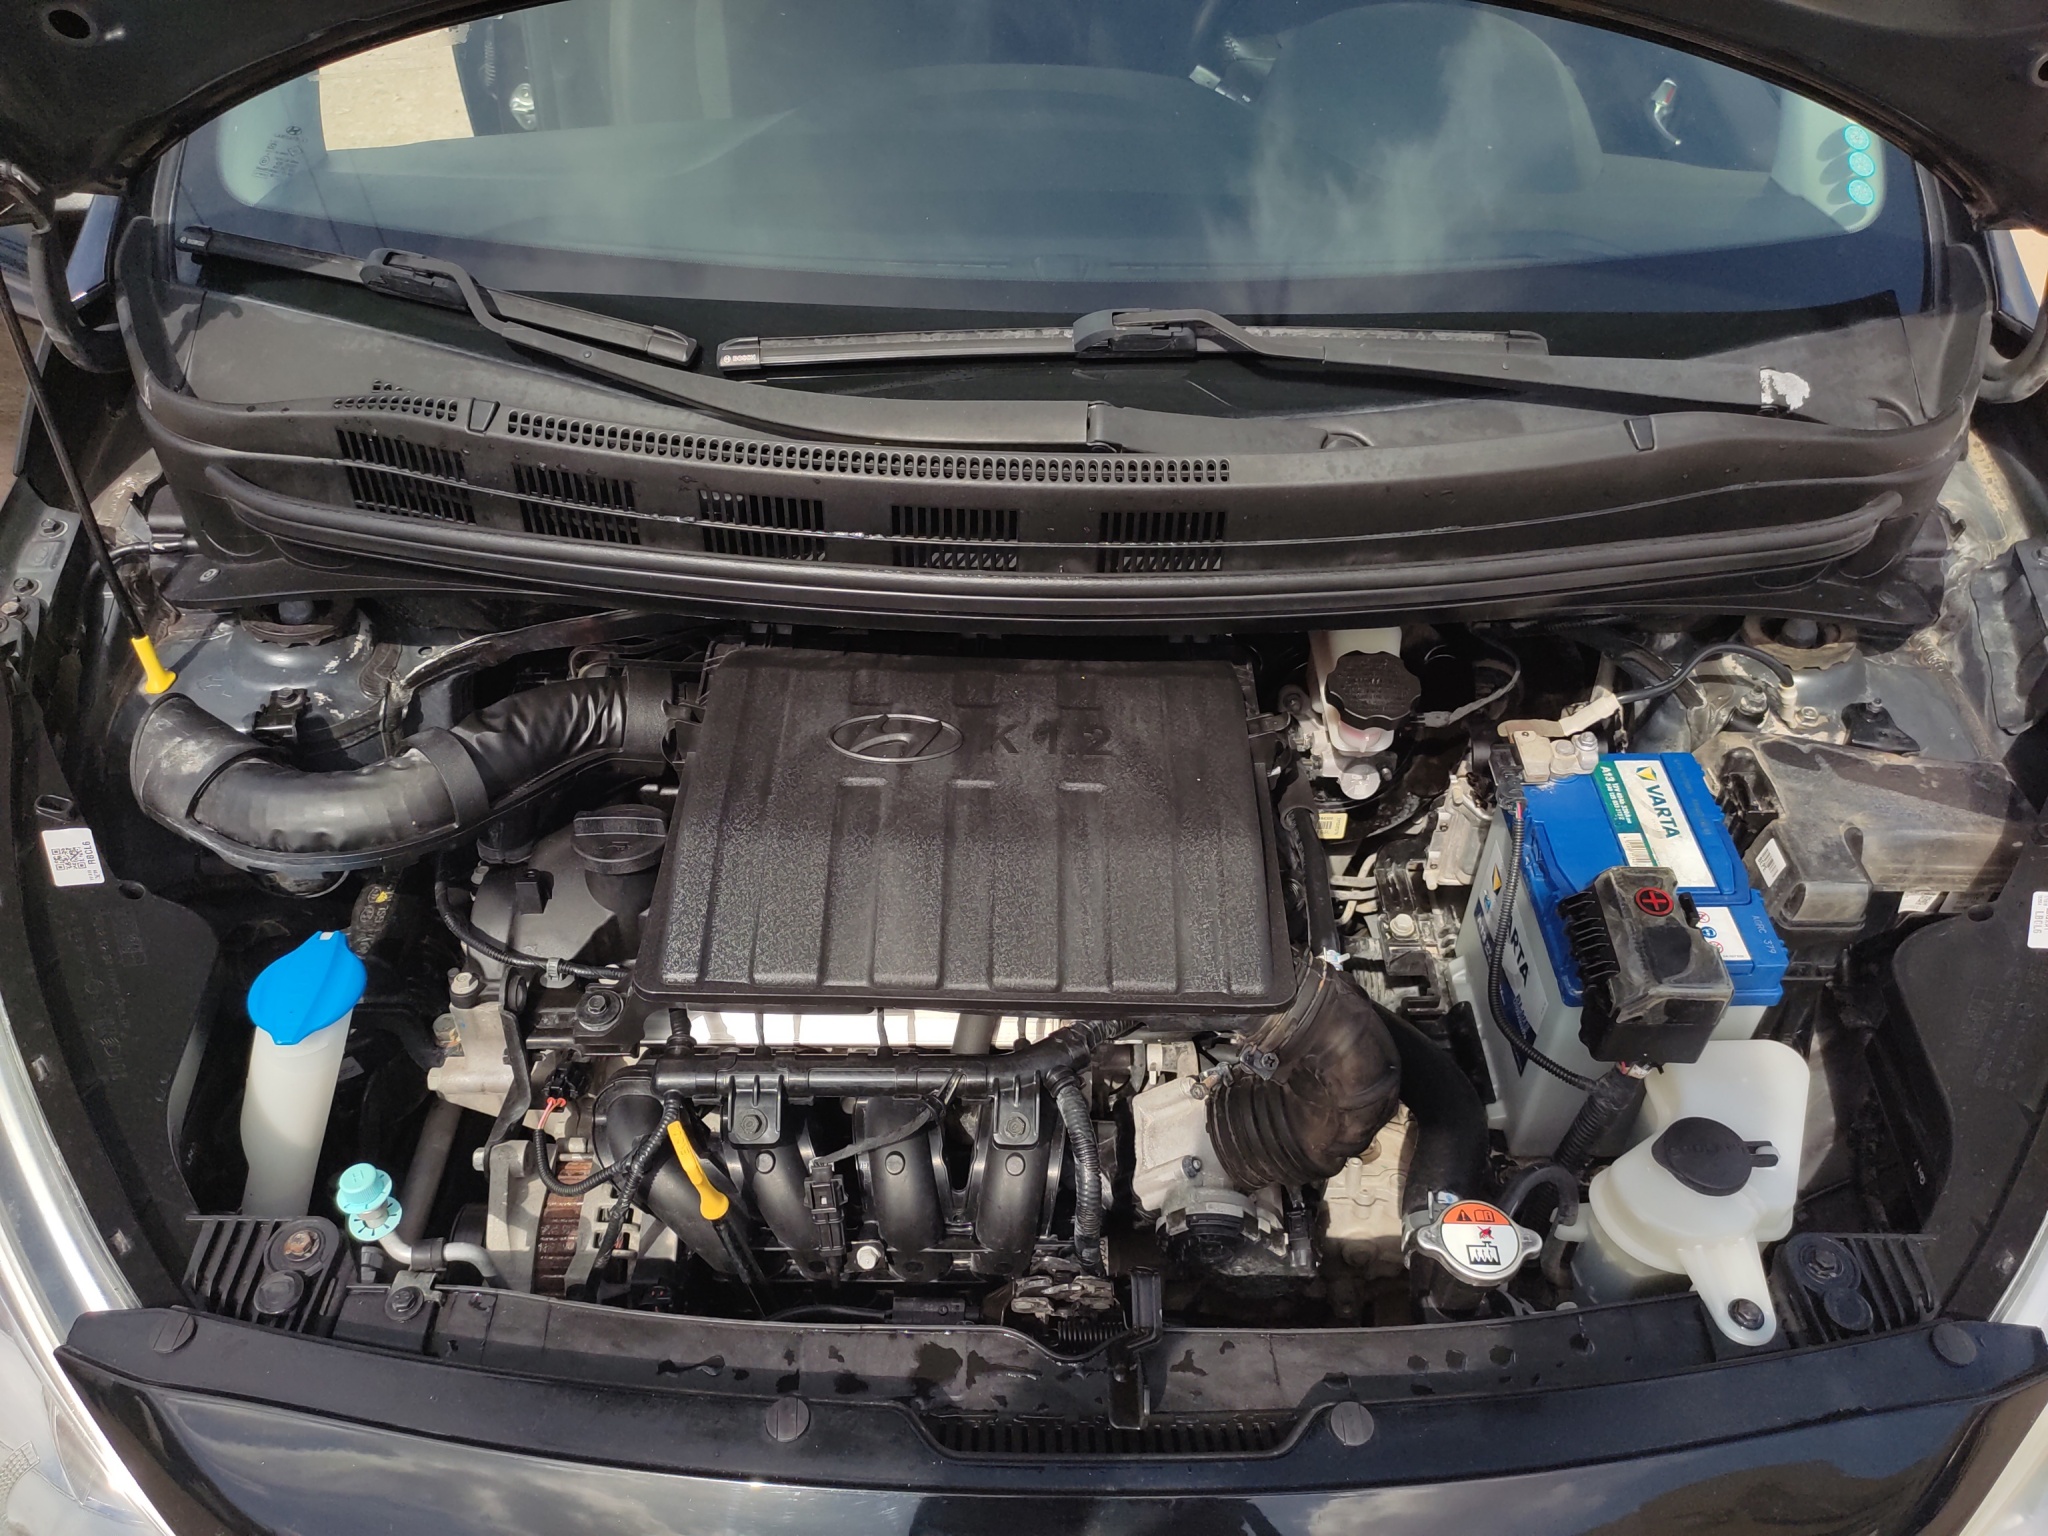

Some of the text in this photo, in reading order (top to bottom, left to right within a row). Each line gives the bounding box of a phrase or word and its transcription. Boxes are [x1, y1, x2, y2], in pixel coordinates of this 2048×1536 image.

[1600, 766, 1616, 782] A13
[1646, 784, 1680, 838] VARTA
[1506, 914, 1530, 988] ARTA
